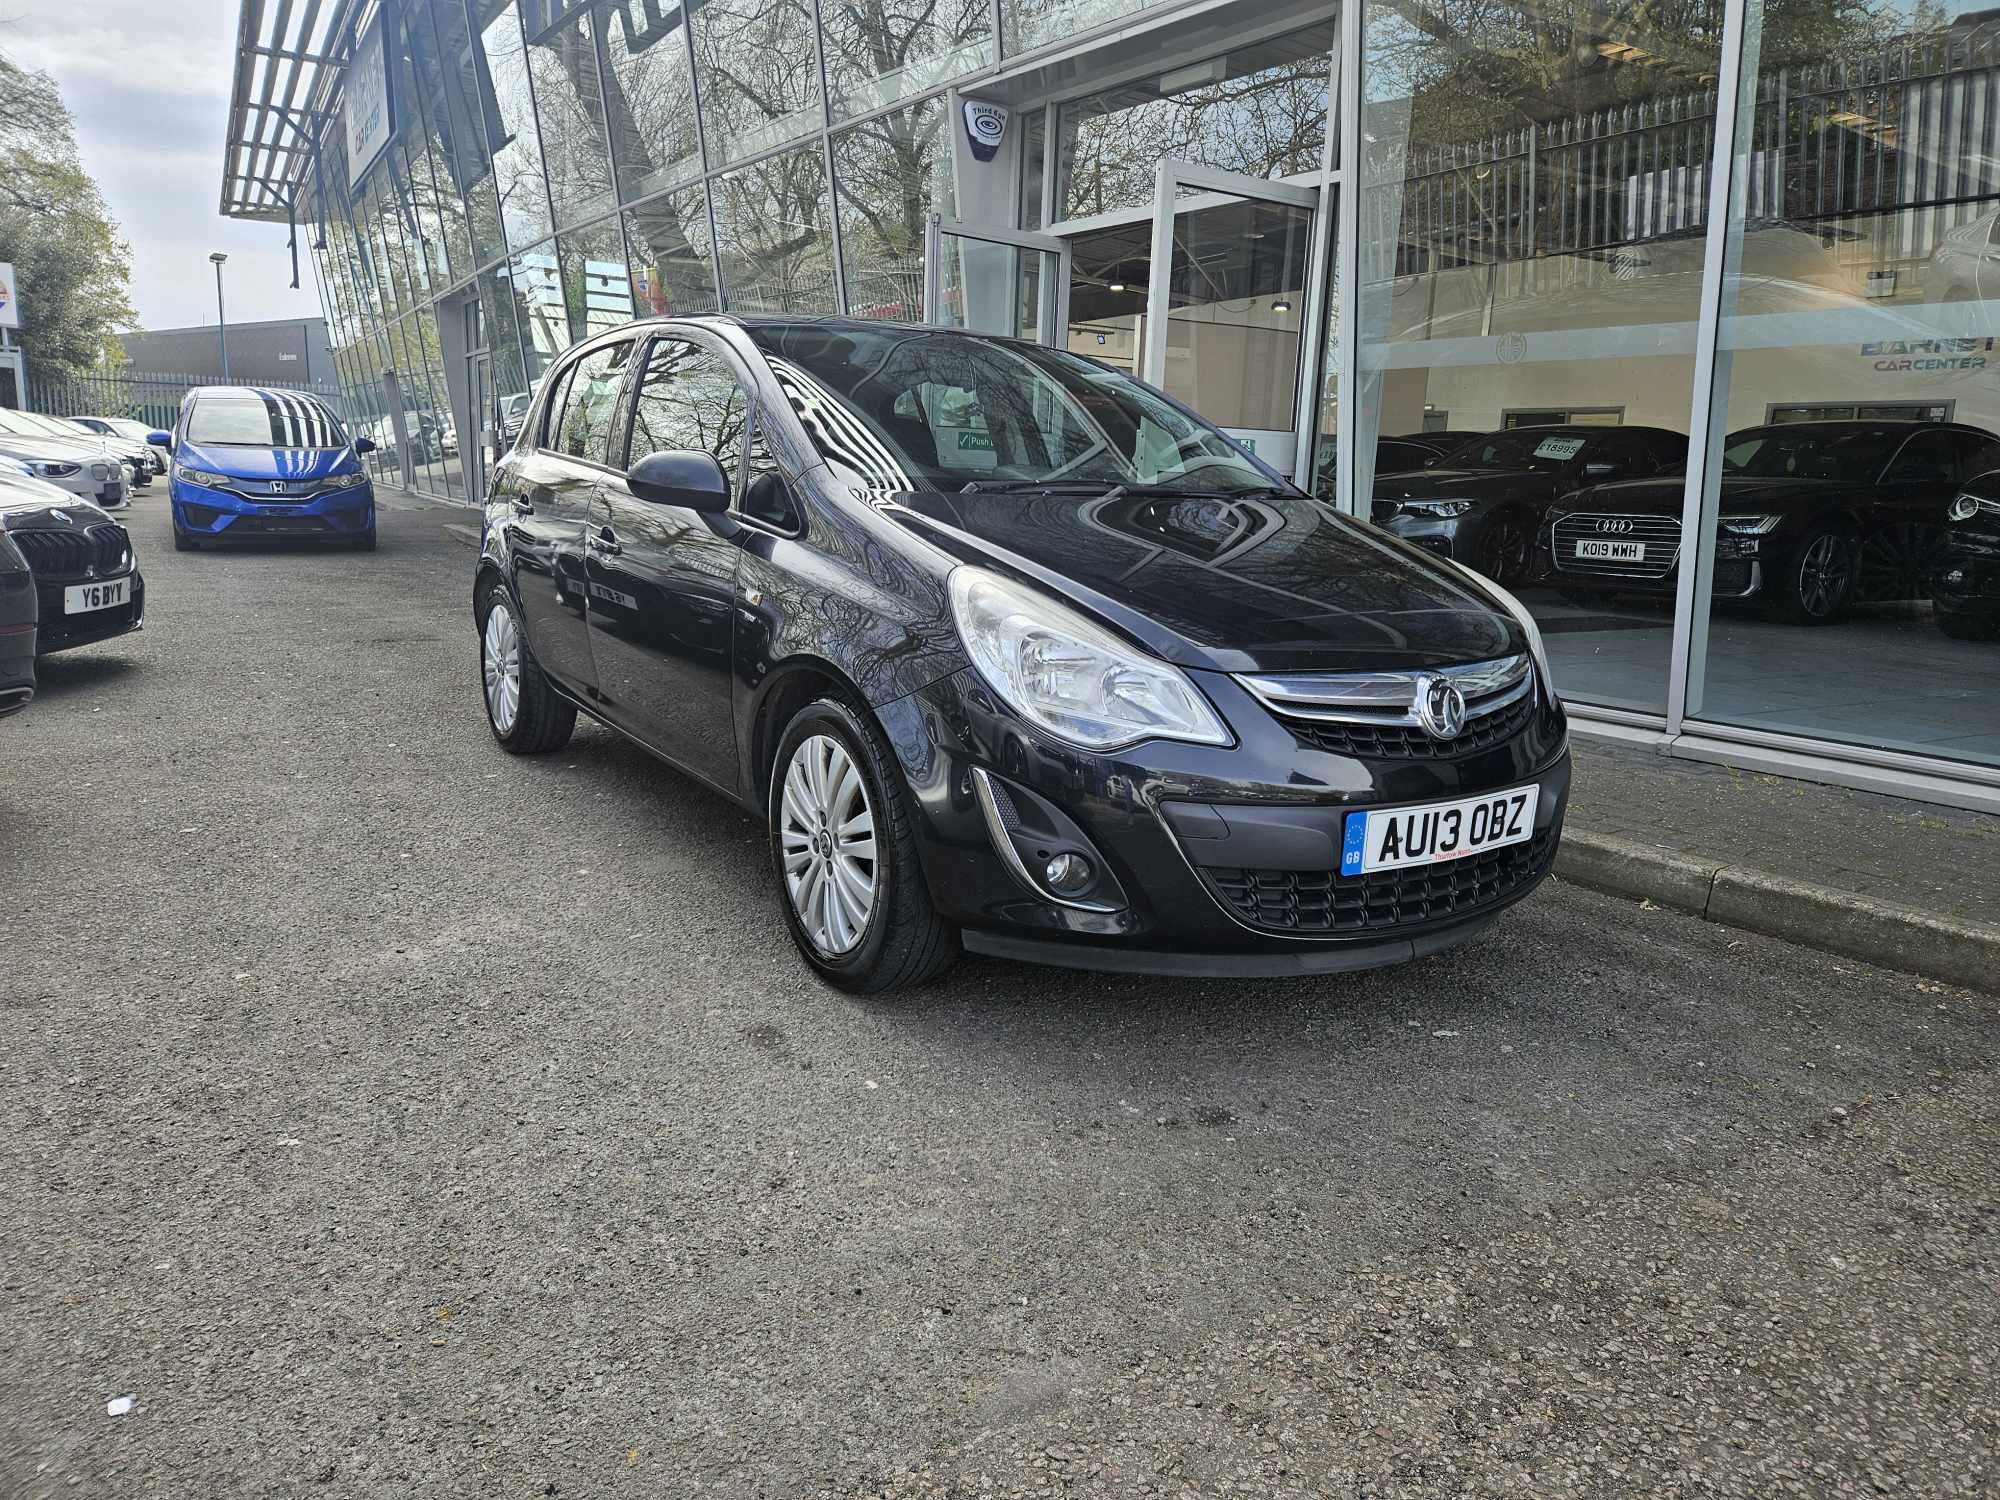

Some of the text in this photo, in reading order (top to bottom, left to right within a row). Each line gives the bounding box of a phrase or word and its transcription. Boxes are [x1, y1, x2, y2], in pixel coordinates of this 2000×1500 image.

[971, 436, 989, 446] Push
[1582, 542, 1638, 558] KO19 WWH
[82, 587, 100, 608] Y6
[1378, 794, 1528, 863] AU13 OBZ
[1345, 851, 1361, 865] GB
